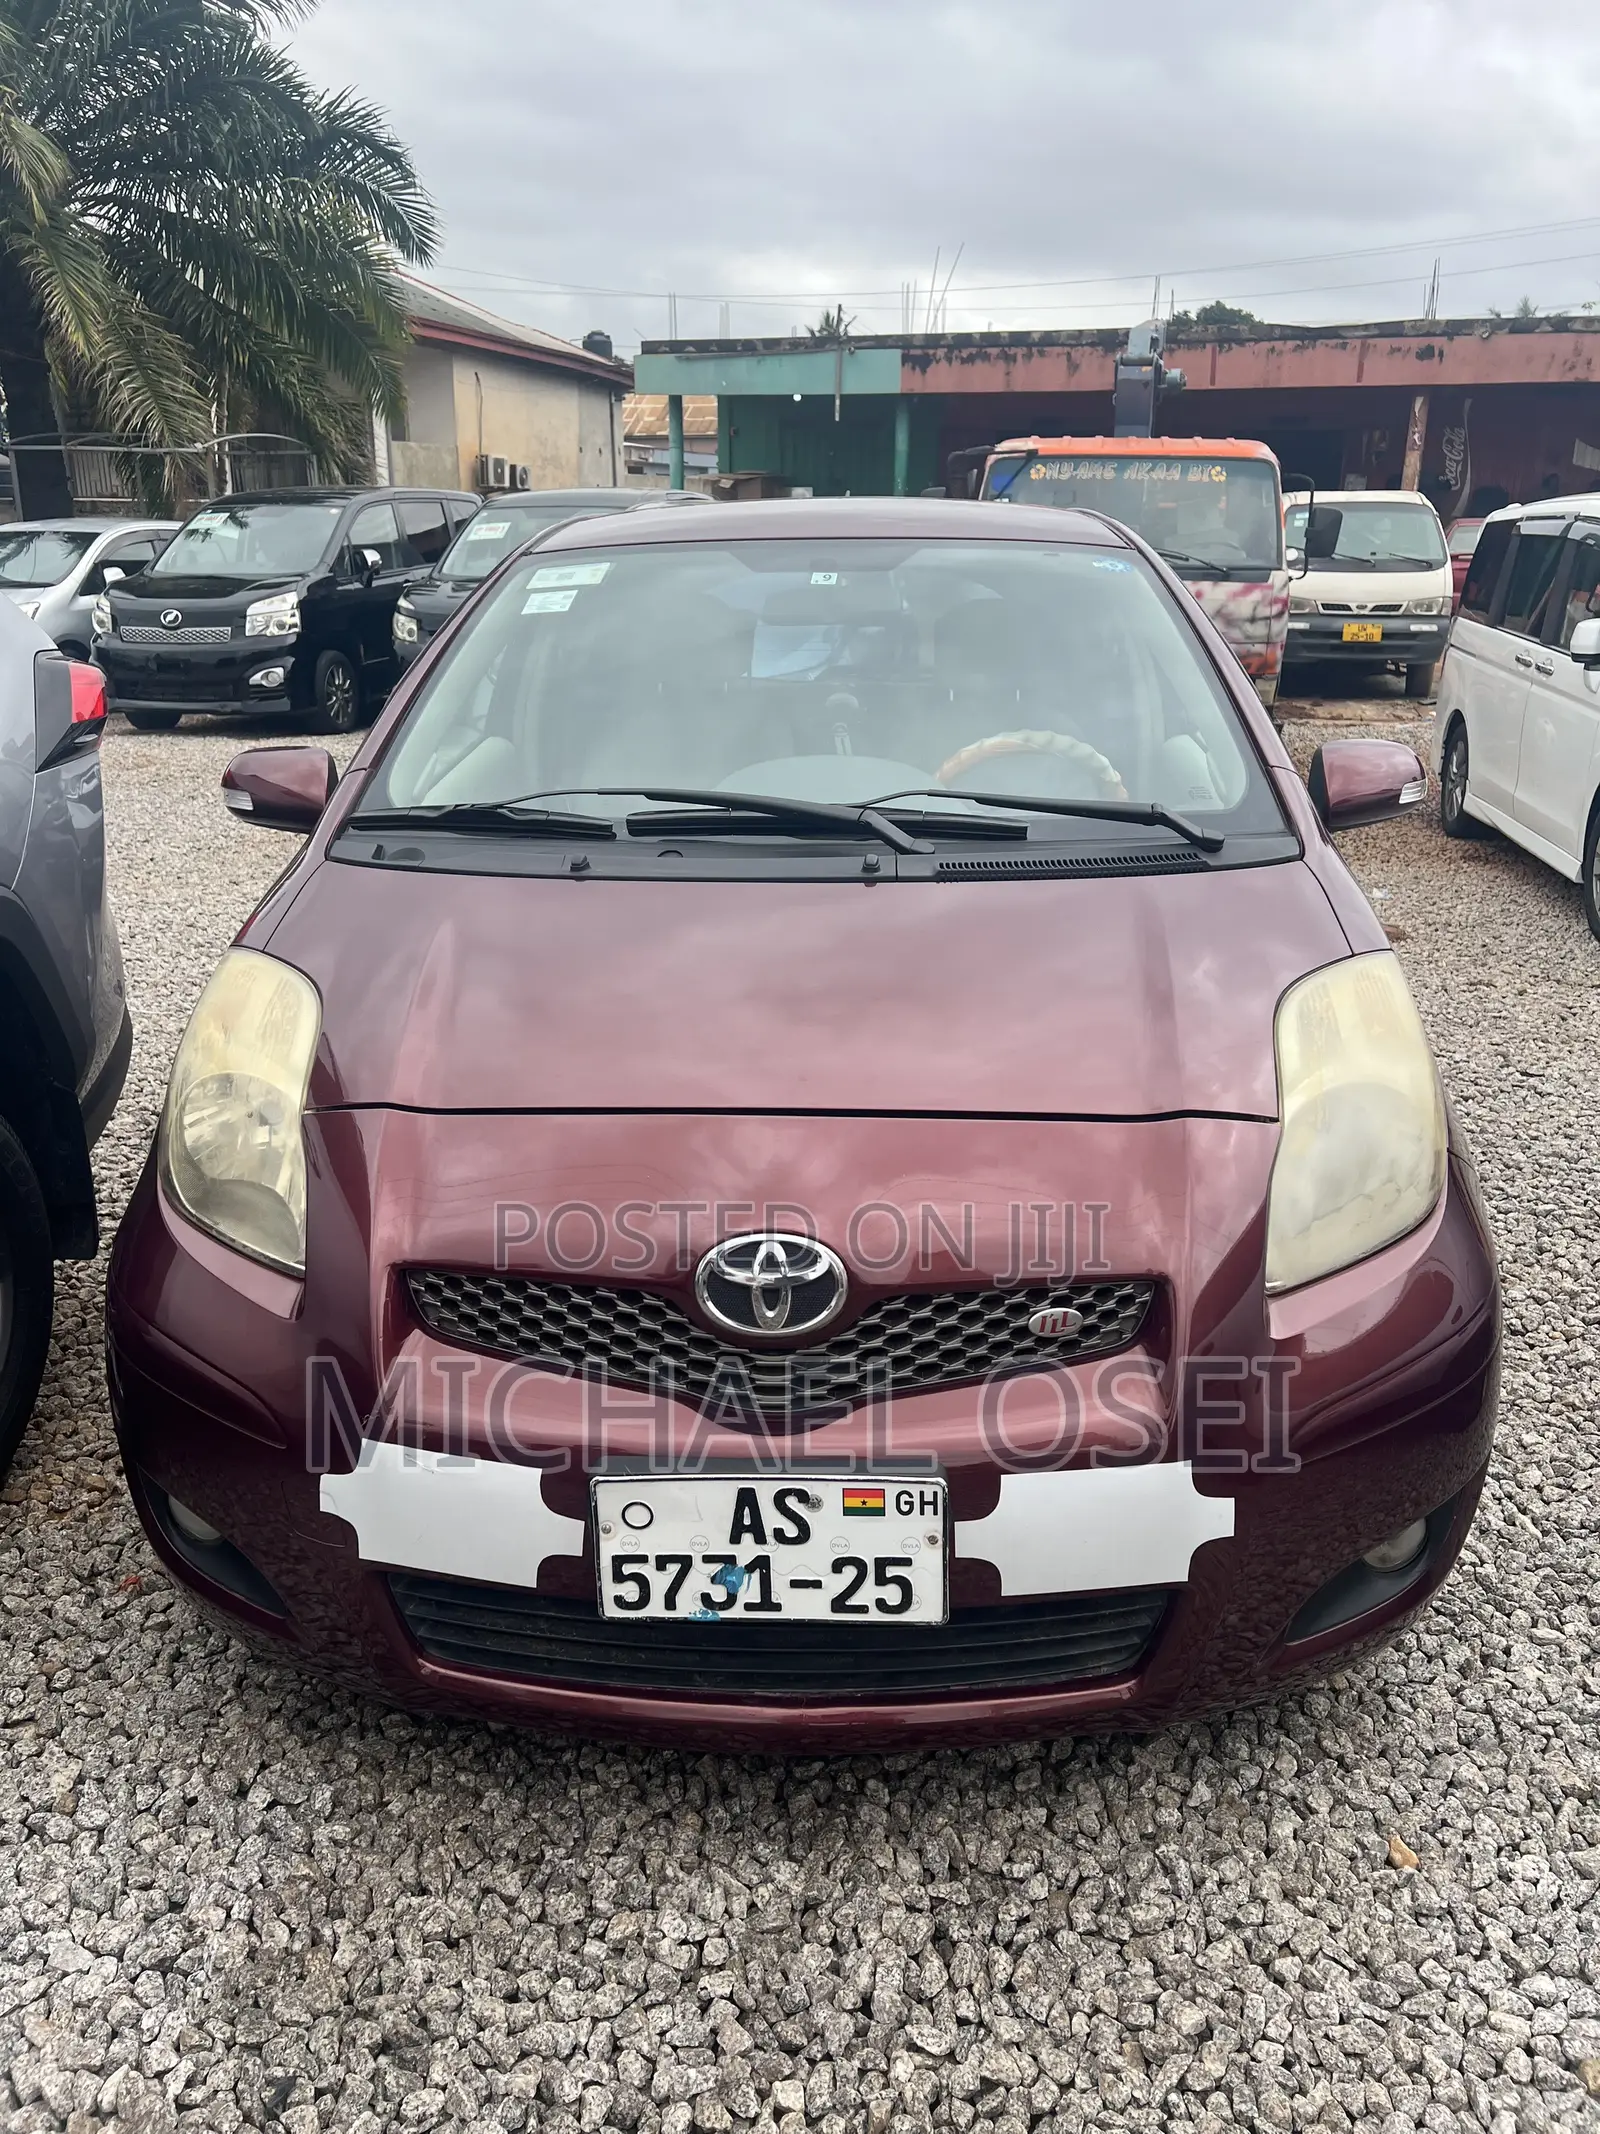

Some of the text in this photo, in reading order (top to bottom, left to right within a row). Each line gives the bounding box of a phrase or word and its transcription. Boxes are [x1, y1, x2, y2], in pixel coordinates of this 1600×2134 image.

[729, 1487, 811, 1546] AS
[895, 1490, 938, 1517] GH
[611, 1554, 914, 1615] 5731-25
